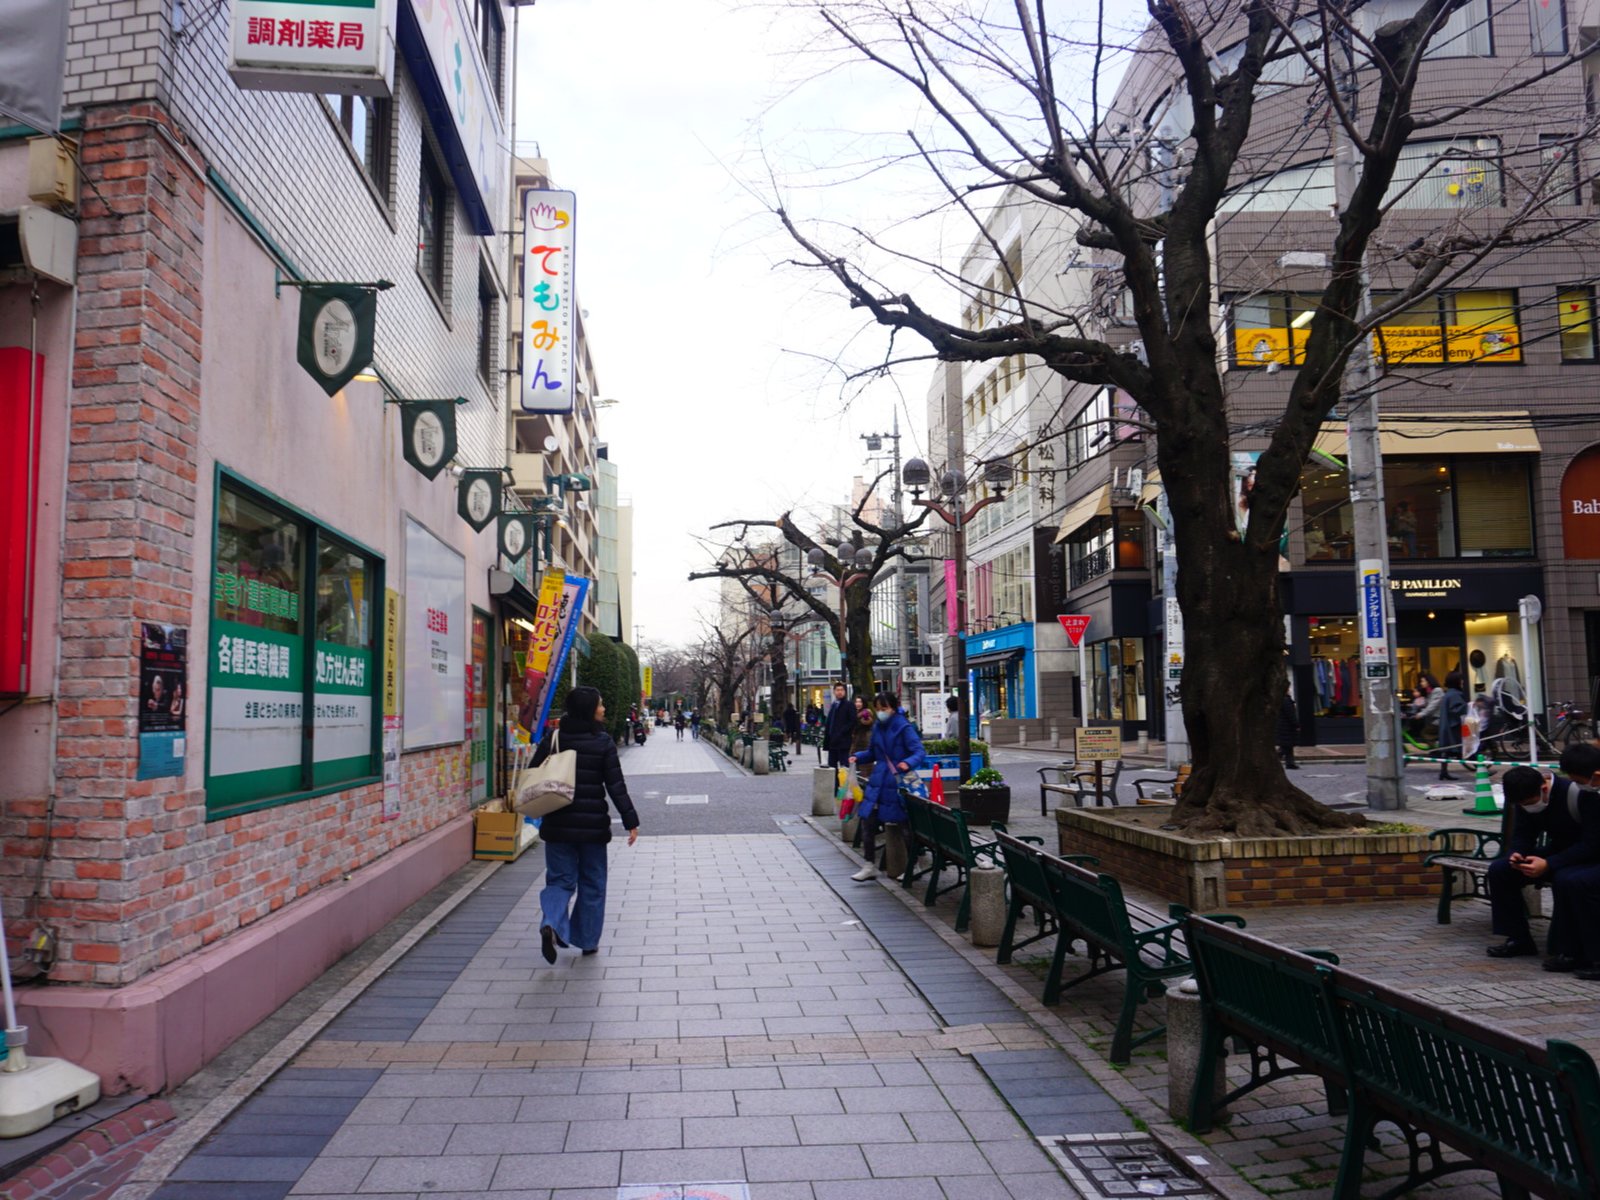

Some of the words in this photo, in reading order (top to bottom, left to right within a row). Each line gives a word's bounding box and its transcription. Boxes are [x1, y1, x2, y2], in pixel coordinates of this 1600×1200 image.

[247, 16, 365, 51] 調剤薬局
[561, 245, 569, 327] RELAXATION
[530, 244, 563, 391] てもみん
[1402, 578, 1462, 589] PAVILLON
[1065, 618, 1085, 627] 止まれ
[218, 633, 290, 679] 各種医療機関
[315, 650, 365, 688] 処方せん受付
